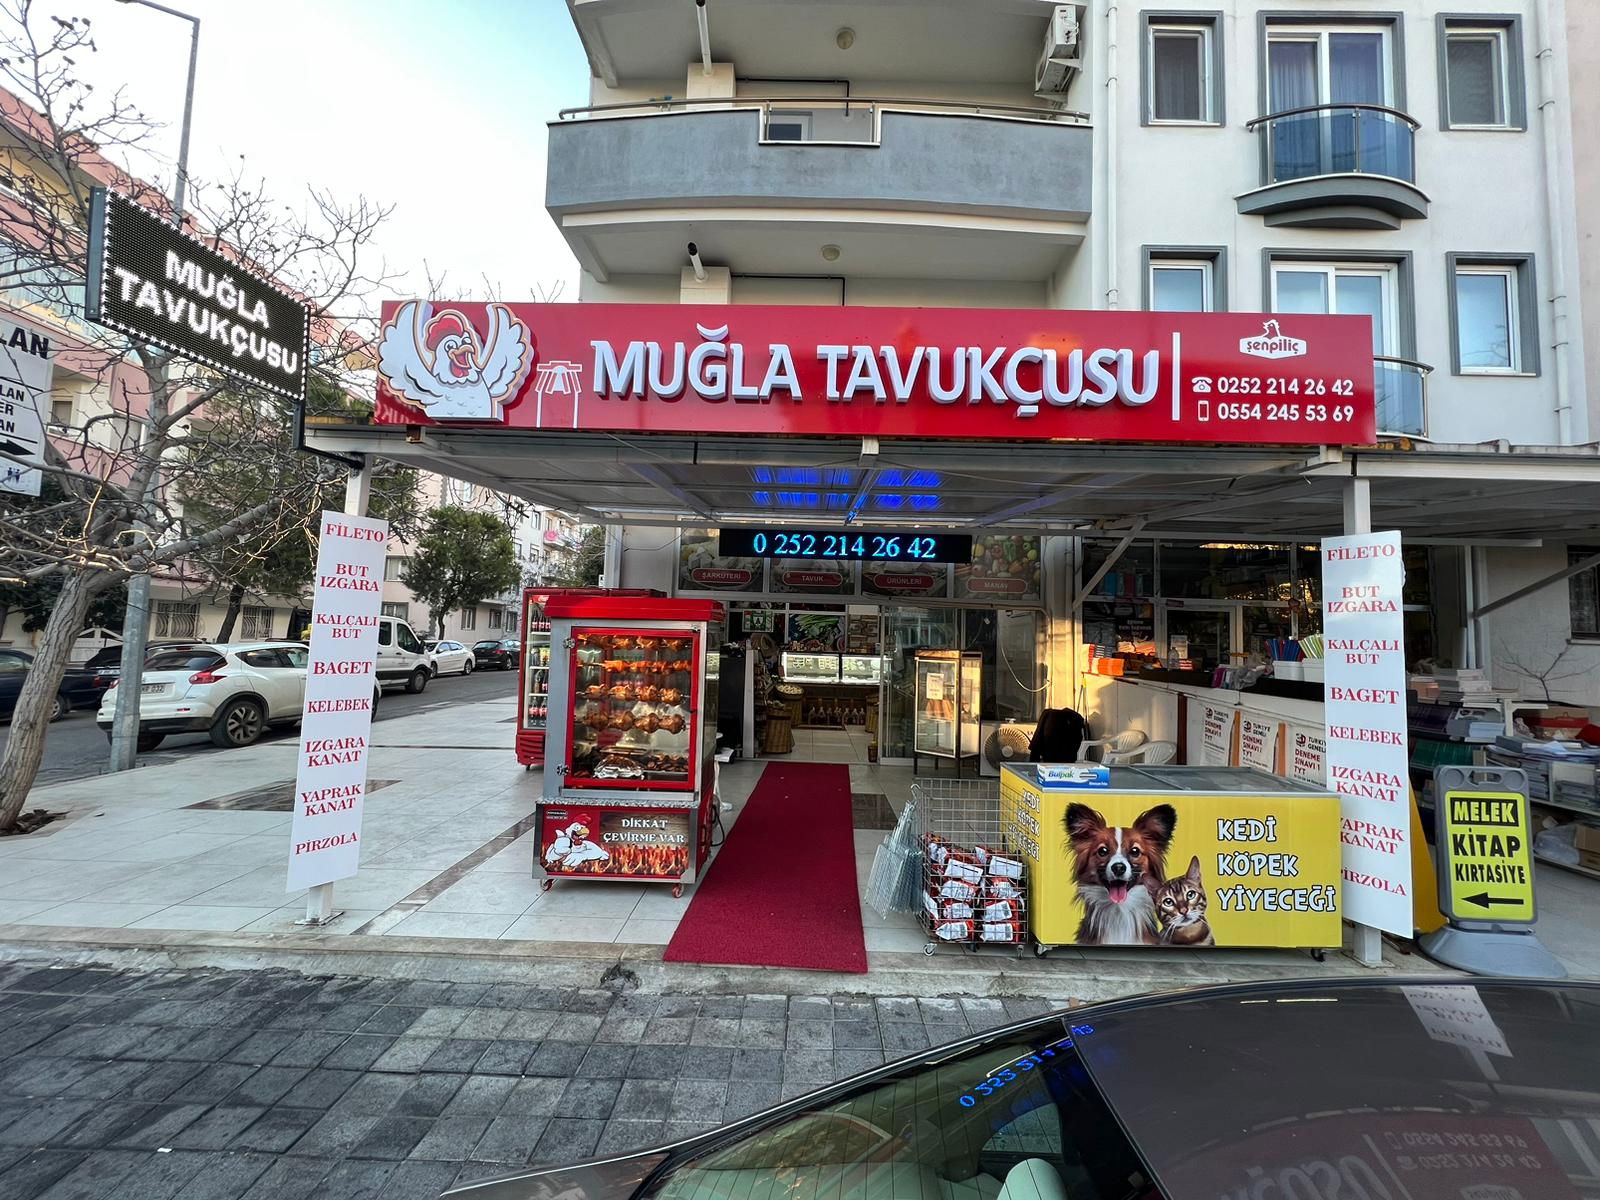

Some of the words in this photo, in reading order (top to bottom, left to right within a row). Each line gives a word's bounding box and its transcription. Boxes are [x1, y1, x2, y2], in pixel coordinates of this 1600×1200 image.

[165, 249, 270, 329] MUĞLA
[113, 265, 298, 376] TAVUKÇUSU
[1246, 338, 1299, 354] şenpiliç
[590, 322, 802, 402] MUĞLA
[817, 344, 1160, 418] TAVUKÇUSU
[1217, 376, 1262, 395] 0252
[1266, 377, 1300, 395] 214
[1304, 378, 1326, 396] 26
[1331, 379, 1354, 396] 42
[1217, 402, 1262, 421] 0554
[1266, 402, 1300, 421] 245
[1305, 404, 1327, 422] 53
[1332, 405, 1354, 422] 69
[325, 523, 385, 543] FİLETO
[753, 533, 767, 554] 0
[774, 533, 817, 556] 252
[823, 534, 865, 557] 214
[872, 535, 900, 558] 26
[907, 536, 936, 559] 42
[1327, 544, 1396, 562] FİLETO
[335, 563, 369, 577] BUT
[801, 574, 824, 583] TAVUK
[319, 576, 380, 592] IZGARA
[1342, 585, 1380, 598] BUT
[1327, 600, 1397, 613] IZGARA
[332, 628, 362, 639] BUT
[1328, 639, 1400, 652] KALÇALI
[313, 661, 372, 675] BAGET
[1346, 653, 1380, 665] BUT
[307, 698, 370, 714] KELEBEK
[1331, 687, 1400, 705] BAGET
[304, 736, 366, 753] IZGARA
[1329, 725, 1404, 746] KELEBEK
[307, 750, 362, 768] KANAT
[1294, 748, 1321, 762] DENEME
[1294, 765, 1306, 776] TYT
[1331, 766, 1402, 788] IZGARA
[301, 784, 362, 804] YAPRAK
[1336, 780, 1399, 802] KANAT
[305, 797, 357, 817] KANAT
[1454, 801, 1516, 823] MELEK
[621, 817, 668, 829] DİKKAT
[1217, 815, 1277, 842] KEDİ
[1340, 817, 1405, 842] APRAK
[295, 832, 358, 855] PİRZOLA
[603, 831, 656, 844] ÇEVİRME
[658, 834, 685, 843] VAR
[1340, 831, 1398, 855] KANAT
[1452, 828, 1521, 858] KİTAP
[1217, 851, 1299, 877] KÖPEK
[1455, 860, 1526, 884] KIRTASİYE
[1340, 866, 1407, 897] İRZOLA
[1216, 884, 1337, 912] YİYECEĞİ
